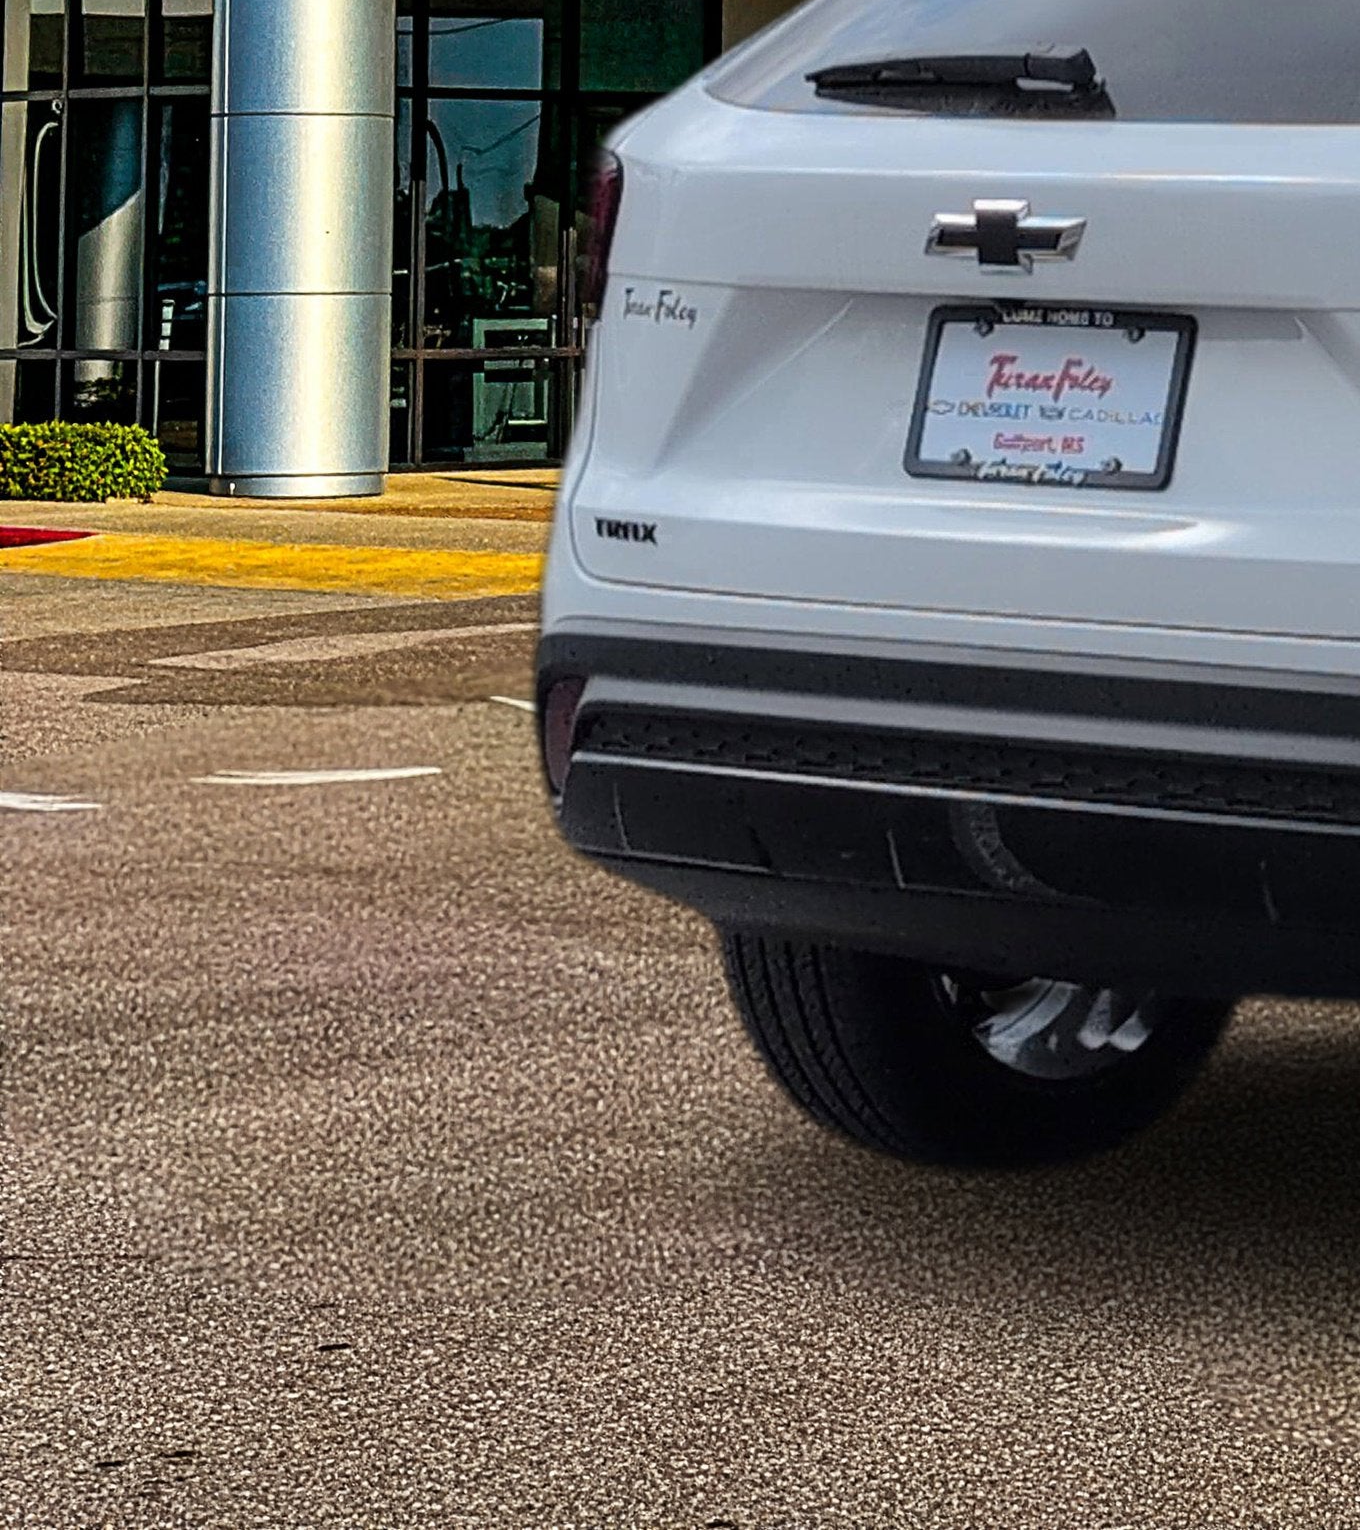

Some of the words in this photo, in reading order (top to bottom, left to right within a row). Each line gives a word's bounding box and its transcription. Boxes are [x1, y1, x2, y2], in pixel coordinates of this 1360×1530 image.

[1094, 311, 1115, 327] TO
[986, 355, 1056, 399] Turan
[1052, 358, 1113, 403] Foley
[1067, 407, 1163, 426] CADILLAC
[1061, 435, 1085, 454] MS
[594, 516, 658, 545] TRAX
